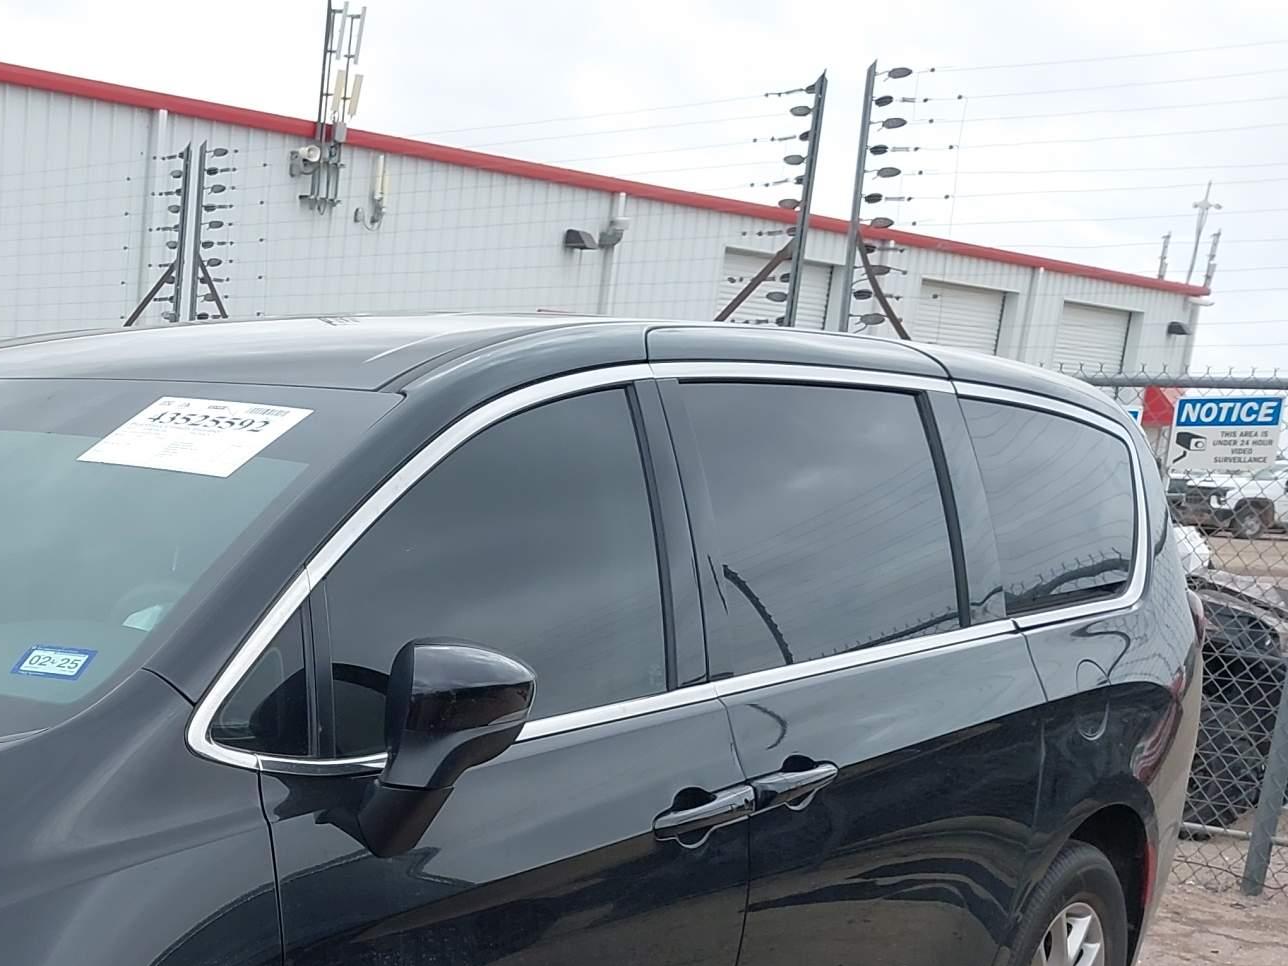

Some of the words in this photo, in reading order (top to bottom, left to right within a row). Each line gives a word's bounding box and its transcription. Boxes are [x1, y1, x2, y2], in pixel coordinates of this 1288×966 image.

[1180, 401, 1278, 423] NOTICE
[148, 411, 271, 433] 43525592
[1220, 430, 1237, 438] THIS
[1239, 430, 1259, 438] AREA
[1260, 430, 1269, 438] IS
[1212, 439, 1238, 447] UNDER
[1239, 439, 1250, 447] 24
[1252, 439, 1274, 447] HOUR
[1231, 447, 1253, 455] VIDEO
[1213, 456, 1268, 464] SURVEILLANCE
